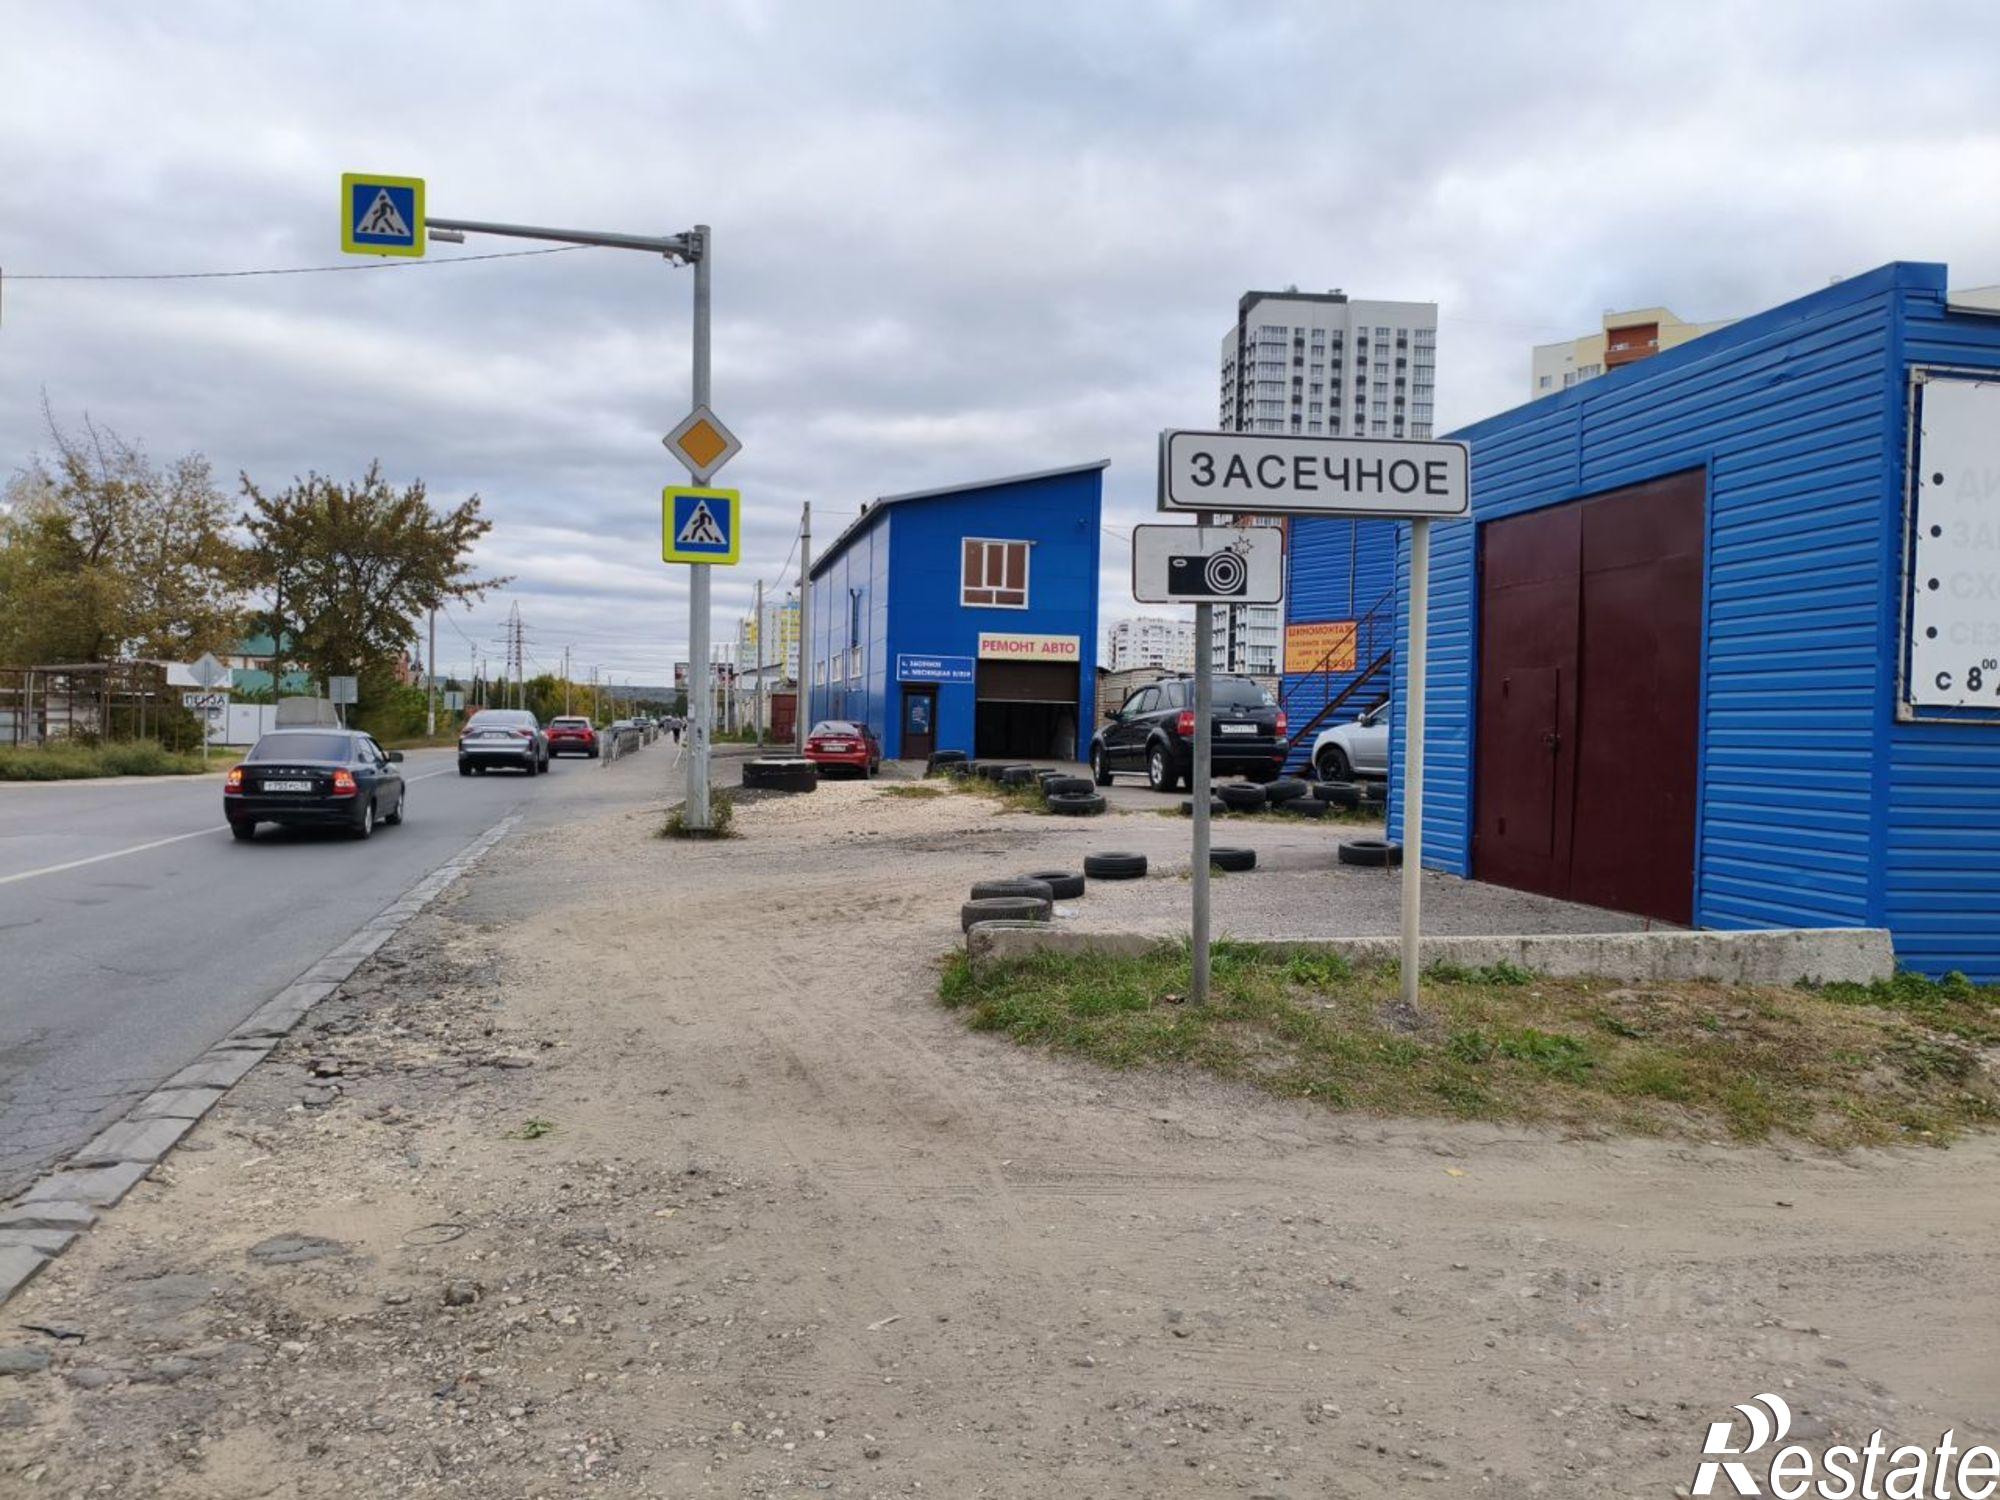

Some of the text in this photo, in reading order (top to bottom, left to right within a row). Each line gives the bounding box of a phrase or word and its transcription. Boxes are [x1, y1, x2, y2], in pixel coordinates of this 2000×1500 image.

[1190, 452, 1449, 495] ЗАСЕЧНОЕ
[982, 640, 1076, 654] РЕМОНТ АВТО
